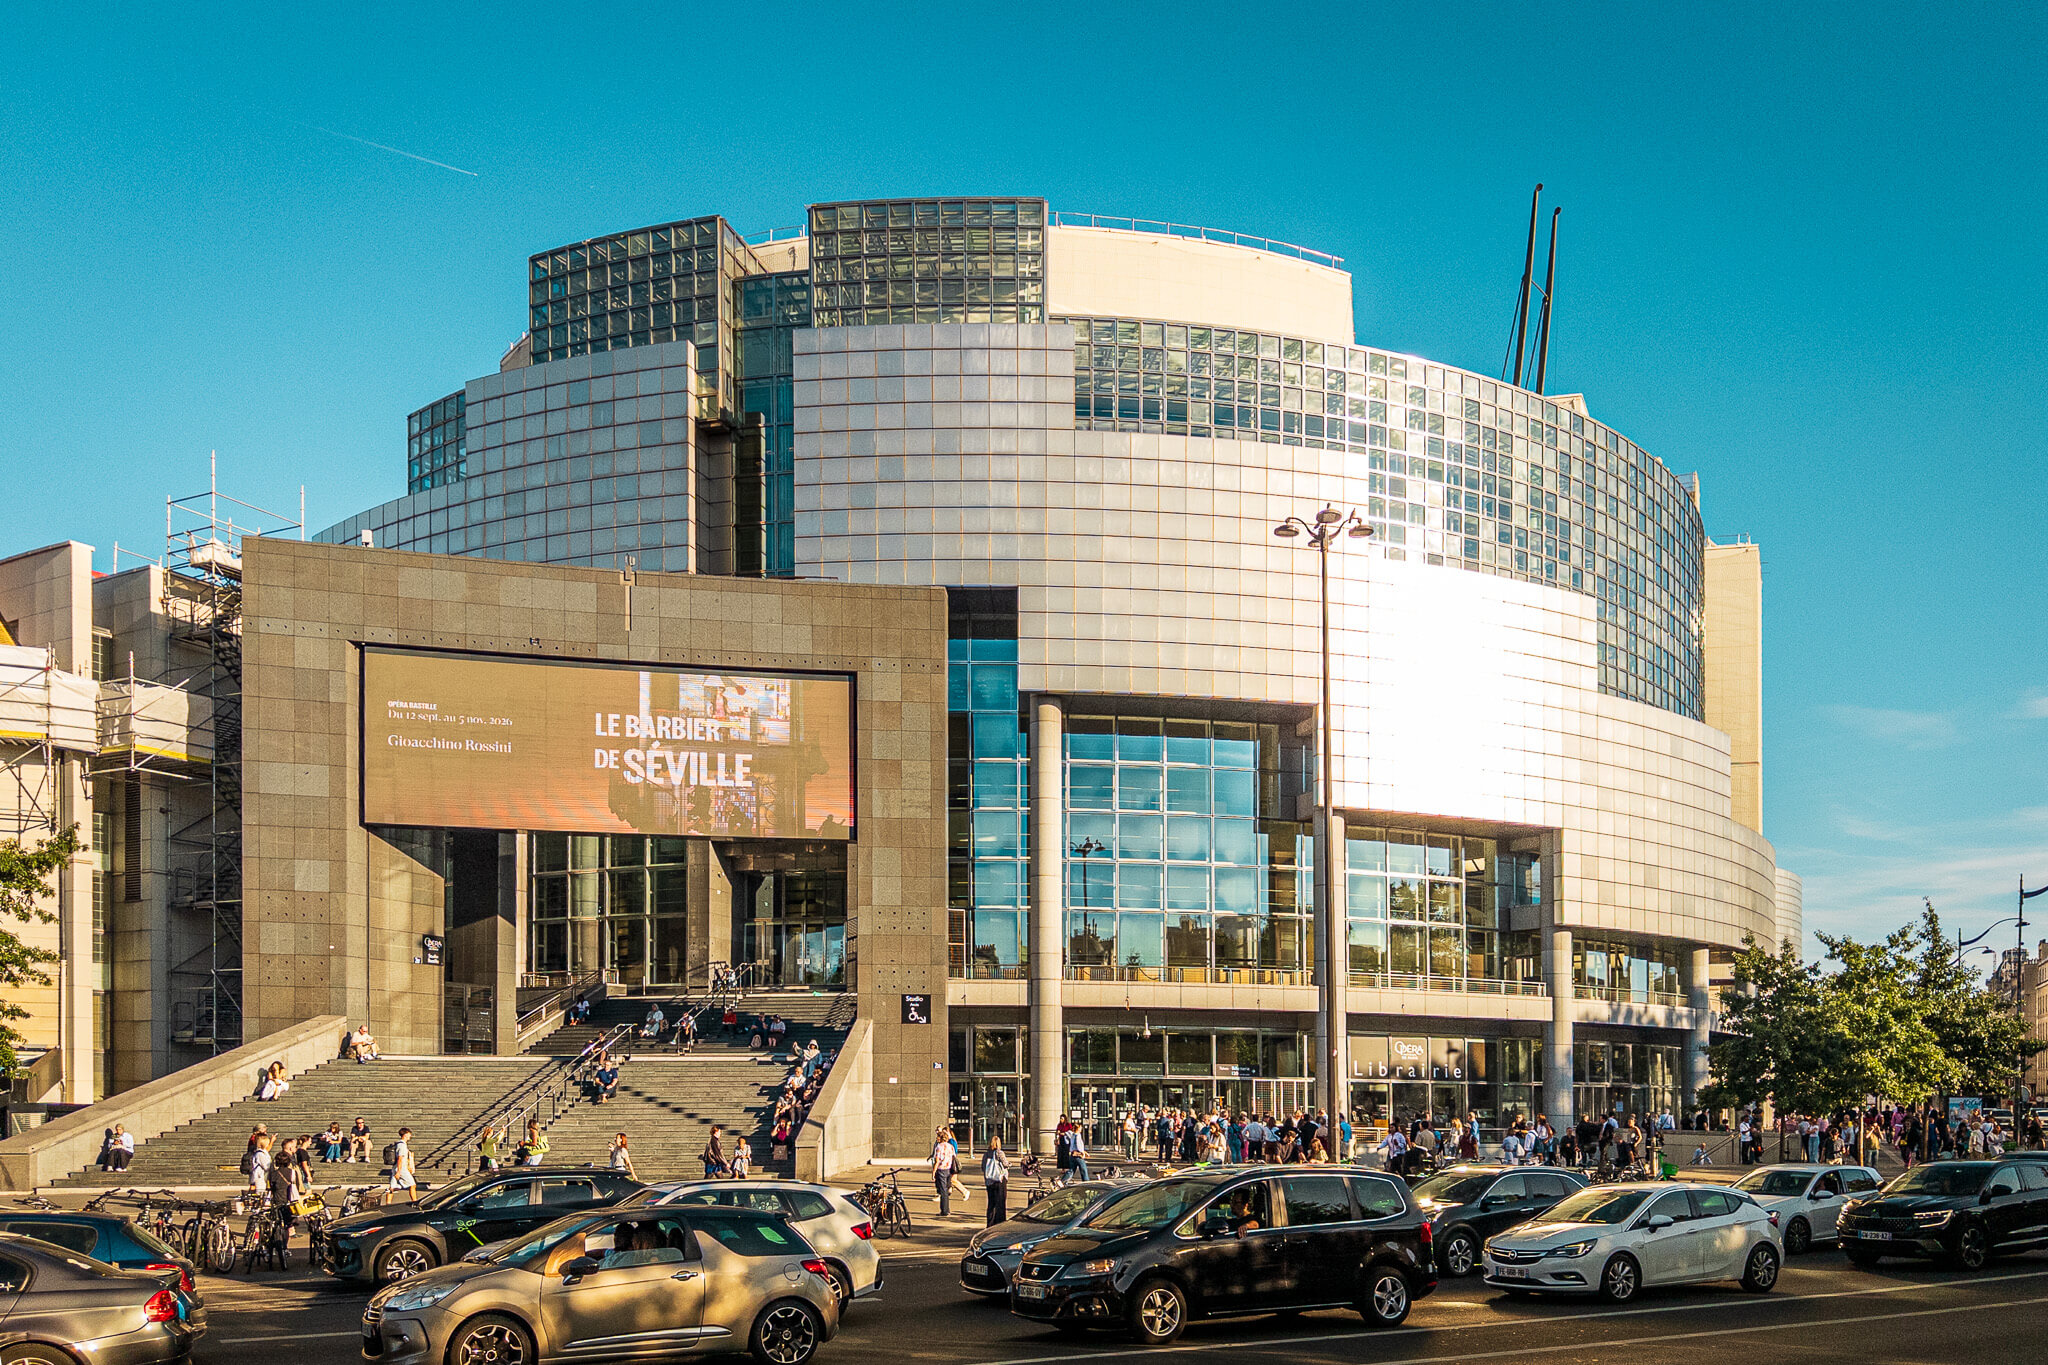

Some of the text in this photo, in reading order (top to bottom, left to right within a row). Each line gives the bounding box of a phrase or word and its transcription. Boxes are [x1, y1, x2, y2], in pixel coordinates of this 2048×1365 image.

[387, 700, 437, 710] OPÉRA BASTILLE
[388, 709, 403, 719] Du
[406, 711, 416, 720] 12
[418, 712, 442, 723] sept.
[443, 714, 456, 722] au
[459, 715, 465, 725] 5
[467, 716, 487, 724] nov.
[595, 713, 720, 742] LE BARBIER
[387, 734, 512, 753] Gioacchino Rossini
[594, 740, 753, 787] DE SÉVILLE
[1353, 1060, 1462, 1078] Librairie
